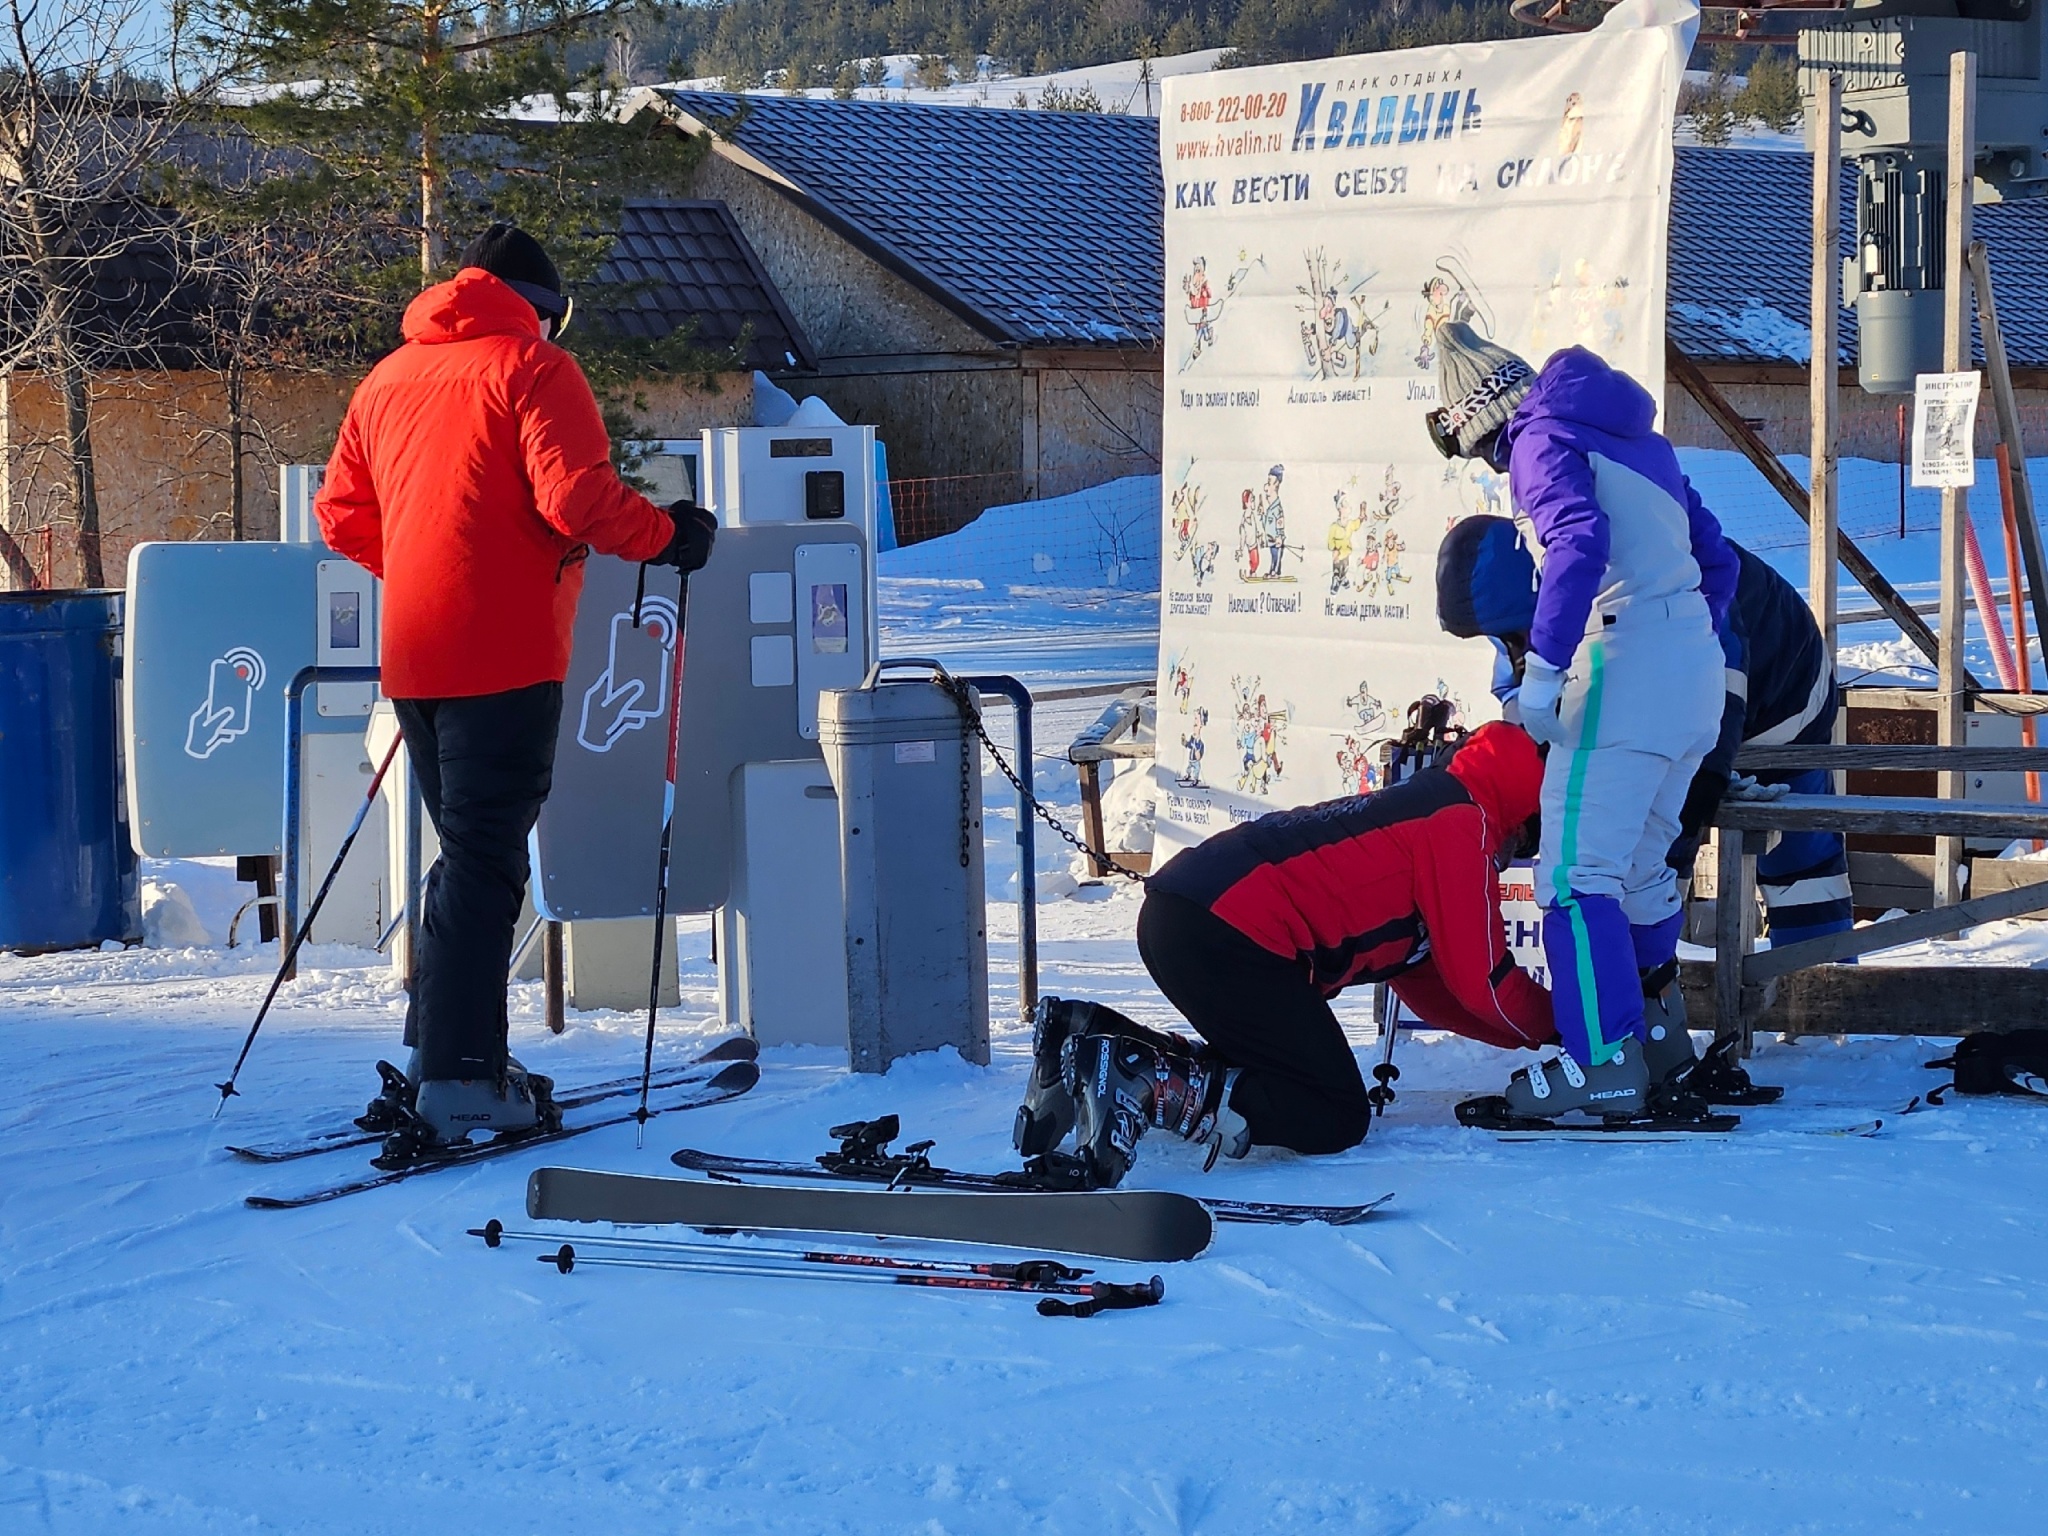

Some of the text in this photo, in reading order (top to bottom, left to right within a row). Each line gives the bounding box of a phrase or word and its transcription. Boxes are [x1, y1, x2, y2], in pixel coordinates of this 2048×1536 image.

[1336, 68, 1463, 92] ПАРК ОТДЫХА
[1176, 130, 1282, 161] www.hvalin.ru
[1175, 179, 1217, 210] КАК
[1231, 173, 1310, 206] ВЕСТИ
[1334, 165, 1408, 199] СЕБЯ
[1924, 381, 1974, 391] ИНСТРУКТОР
[1097, 1038, 1110, 1098] ROSSIGNOL
[1589, 1087, 1637, 1101] HEAD
[449, 1113, 491, 1122] HEAD
